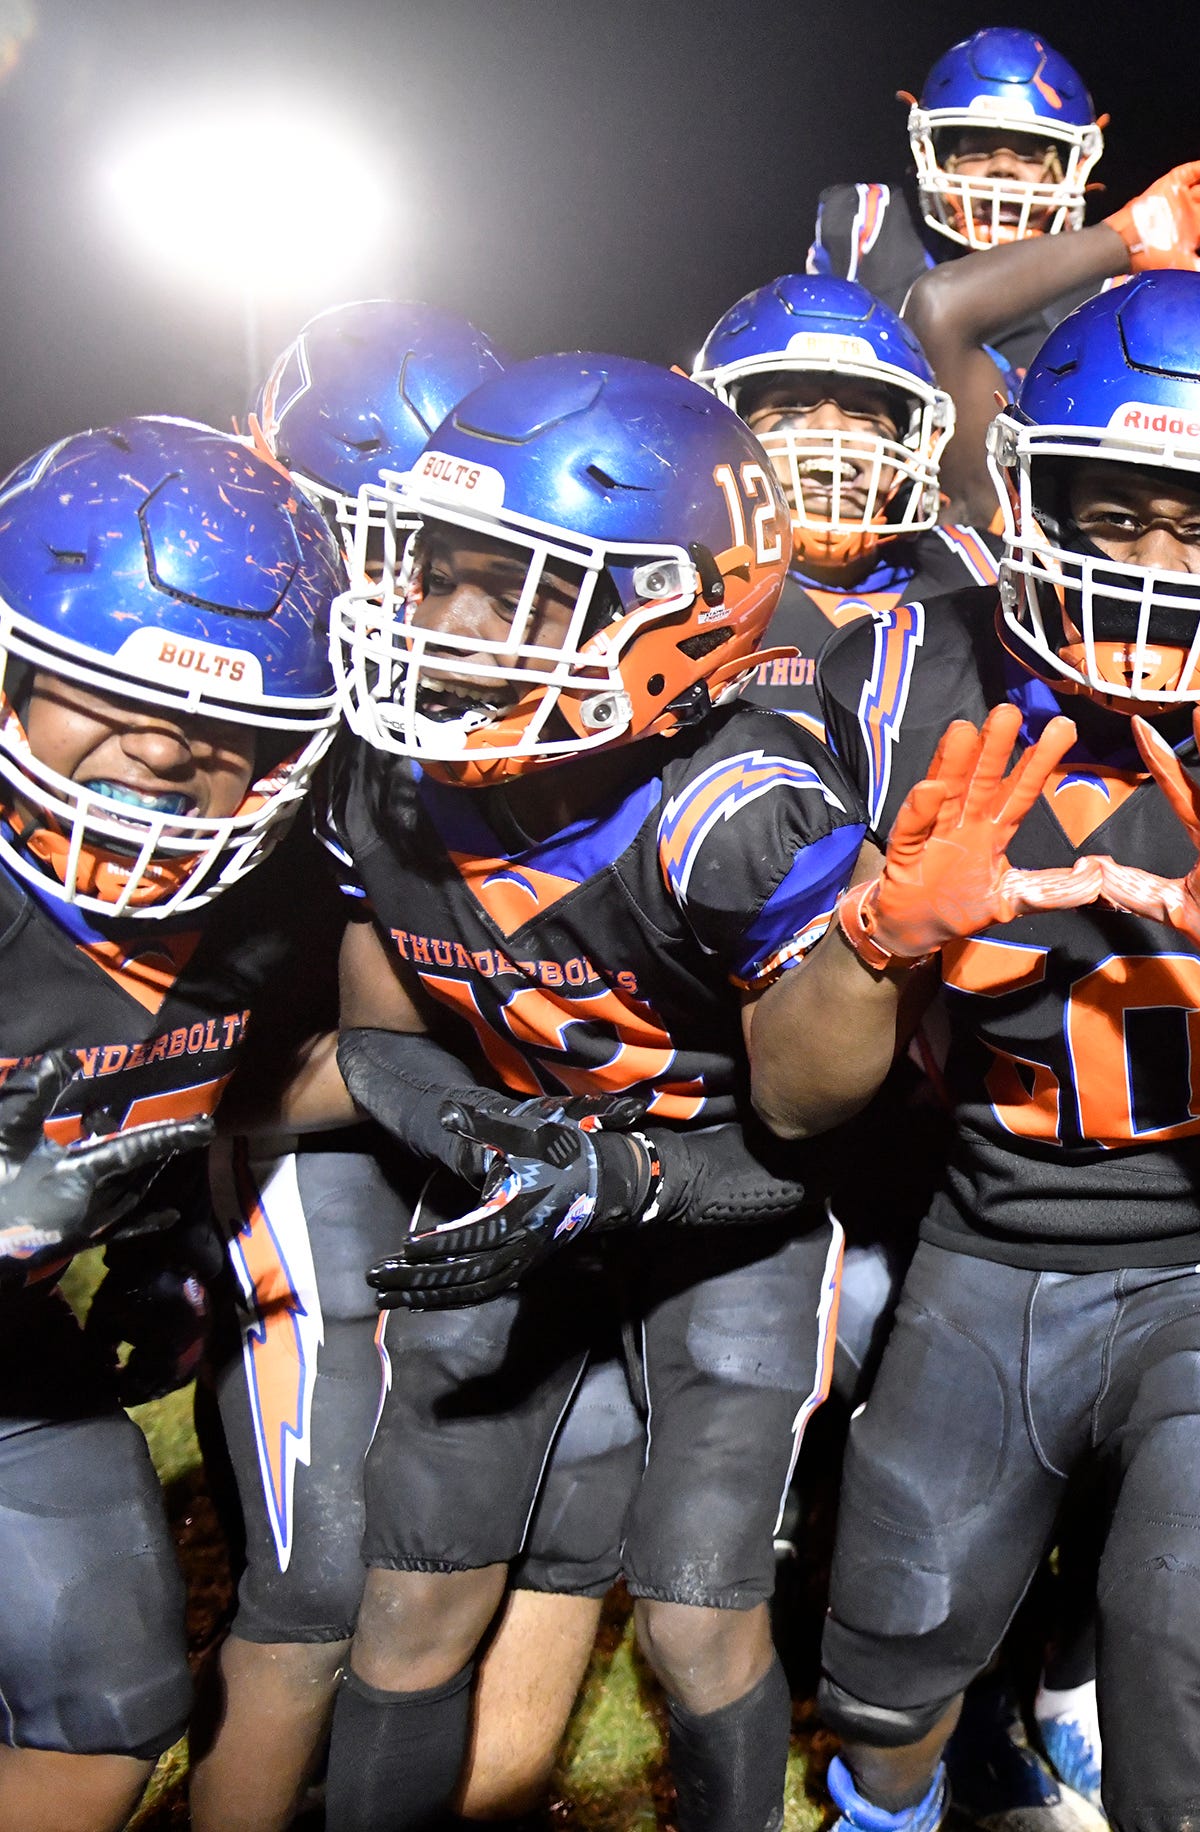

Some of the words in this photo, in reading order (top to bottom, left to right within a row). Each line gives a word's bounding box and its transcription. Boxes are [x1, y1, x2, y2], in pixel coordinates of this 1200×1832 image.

[806, 337, 861, 354] BTS
[423, 456, 481, 490] BOLTS
[713, 460, 783, 569] 12
[158, 641, 246, 682] BOLTS
[390, 928, 638, 995] THUNDEBOLS
[0, 1009, 251, 1087] TNDERBOLT
